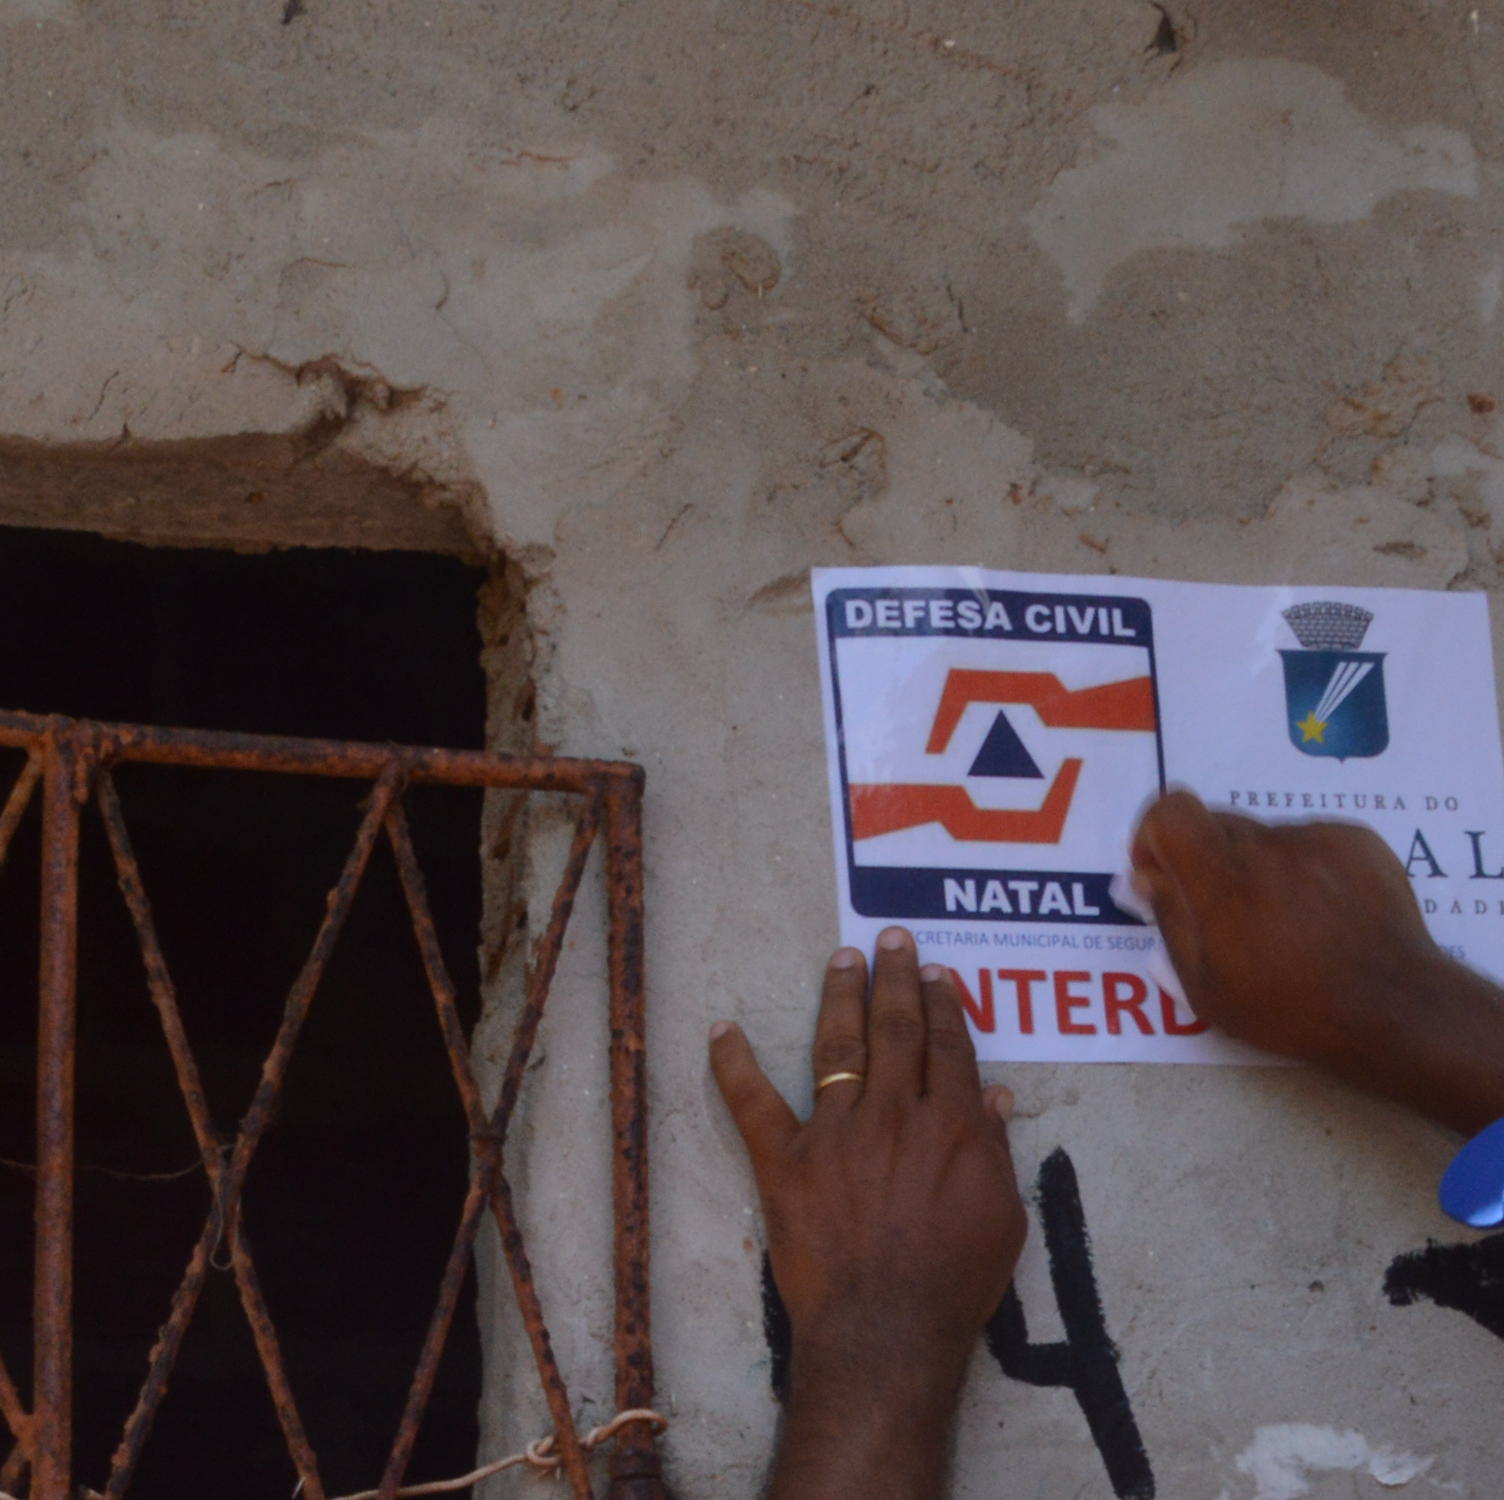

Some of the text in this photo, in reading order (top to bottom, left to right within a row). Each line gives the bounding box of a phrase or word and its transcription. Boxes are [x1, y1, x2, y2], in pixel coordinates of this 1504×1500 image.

[845, 599, 1136, 637] DEFESA CIVIL
[1229, 791, 1459, 811] PREFEITURA DO
[943, 878, 1100, 916] NATAL
[993, 933, 1080, 949] MUNICIPAL
[1084, 935, 1103, 950] DE
